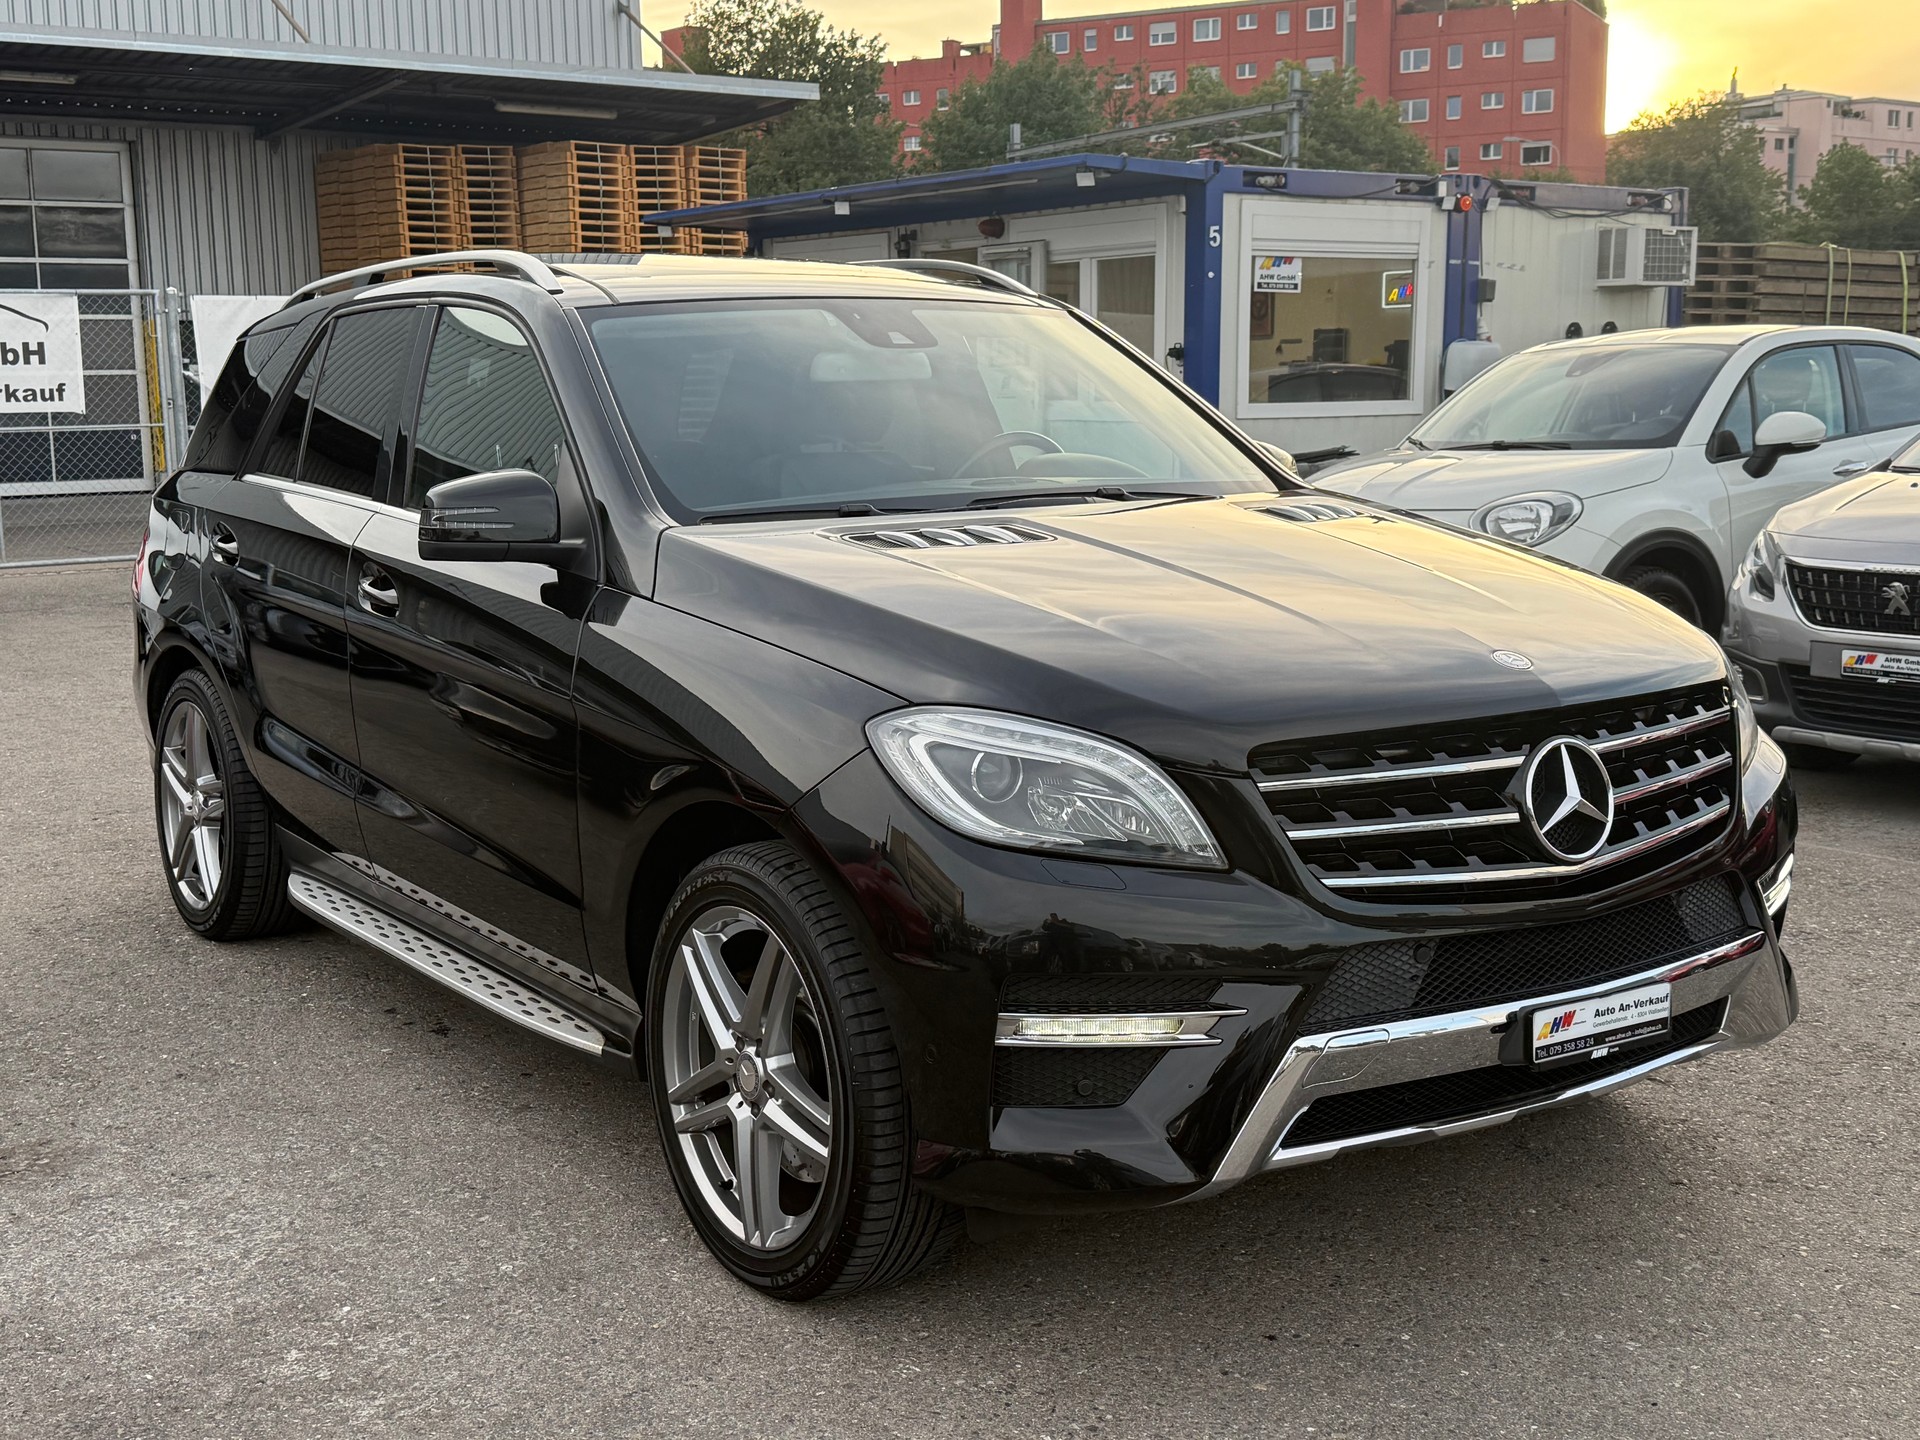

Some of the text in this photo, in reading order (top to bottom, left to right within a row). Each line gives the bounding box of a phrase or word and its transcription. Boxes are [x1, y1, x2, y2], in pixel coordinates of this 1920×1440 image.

[1209, 225, 1221, 247] 5
[1260, 273, 1275, 281] AHW
[0, 383, 66, 403] kauf
[1844, 653, 1879, 667] AHW
[1884, 656, 1902, 664] AHW
[1594, 993, 1670, 1018] Auto An-Verkauf
[1536, 1009, 1577, 1041] AHW
[1605, 1030, 1632, 1042] www.ahw.ch
[1537, 1037, 1594, 1058] Tel. 079 358 58 24
